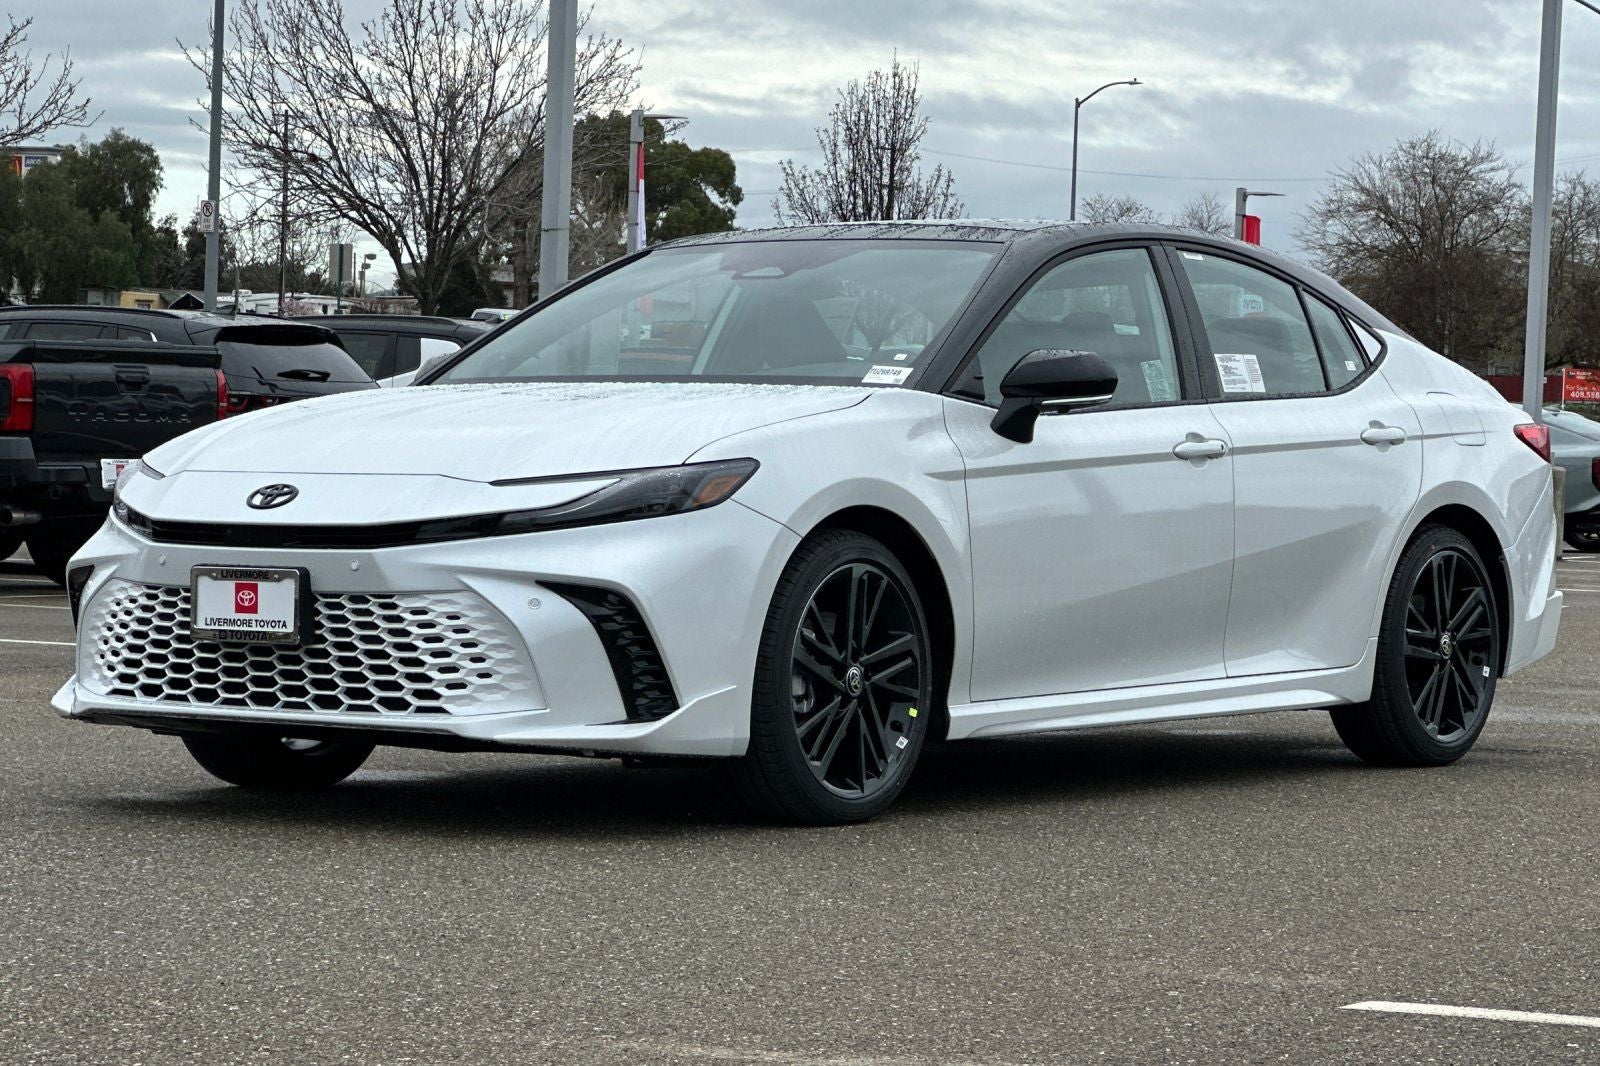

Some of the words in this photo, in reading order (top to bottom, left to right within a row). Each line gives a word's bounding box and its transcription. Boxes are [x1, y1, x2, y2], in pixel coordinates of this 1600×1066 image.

[68, 411, 192, 423] TACOMA
[221, 570, 270, 580] LIVERMORE
[204, 617, 253, 628] LIVERMORE
[254, 619, 288, 629] TOYOTA
[229, 630, 269, 641] TOYOTA
